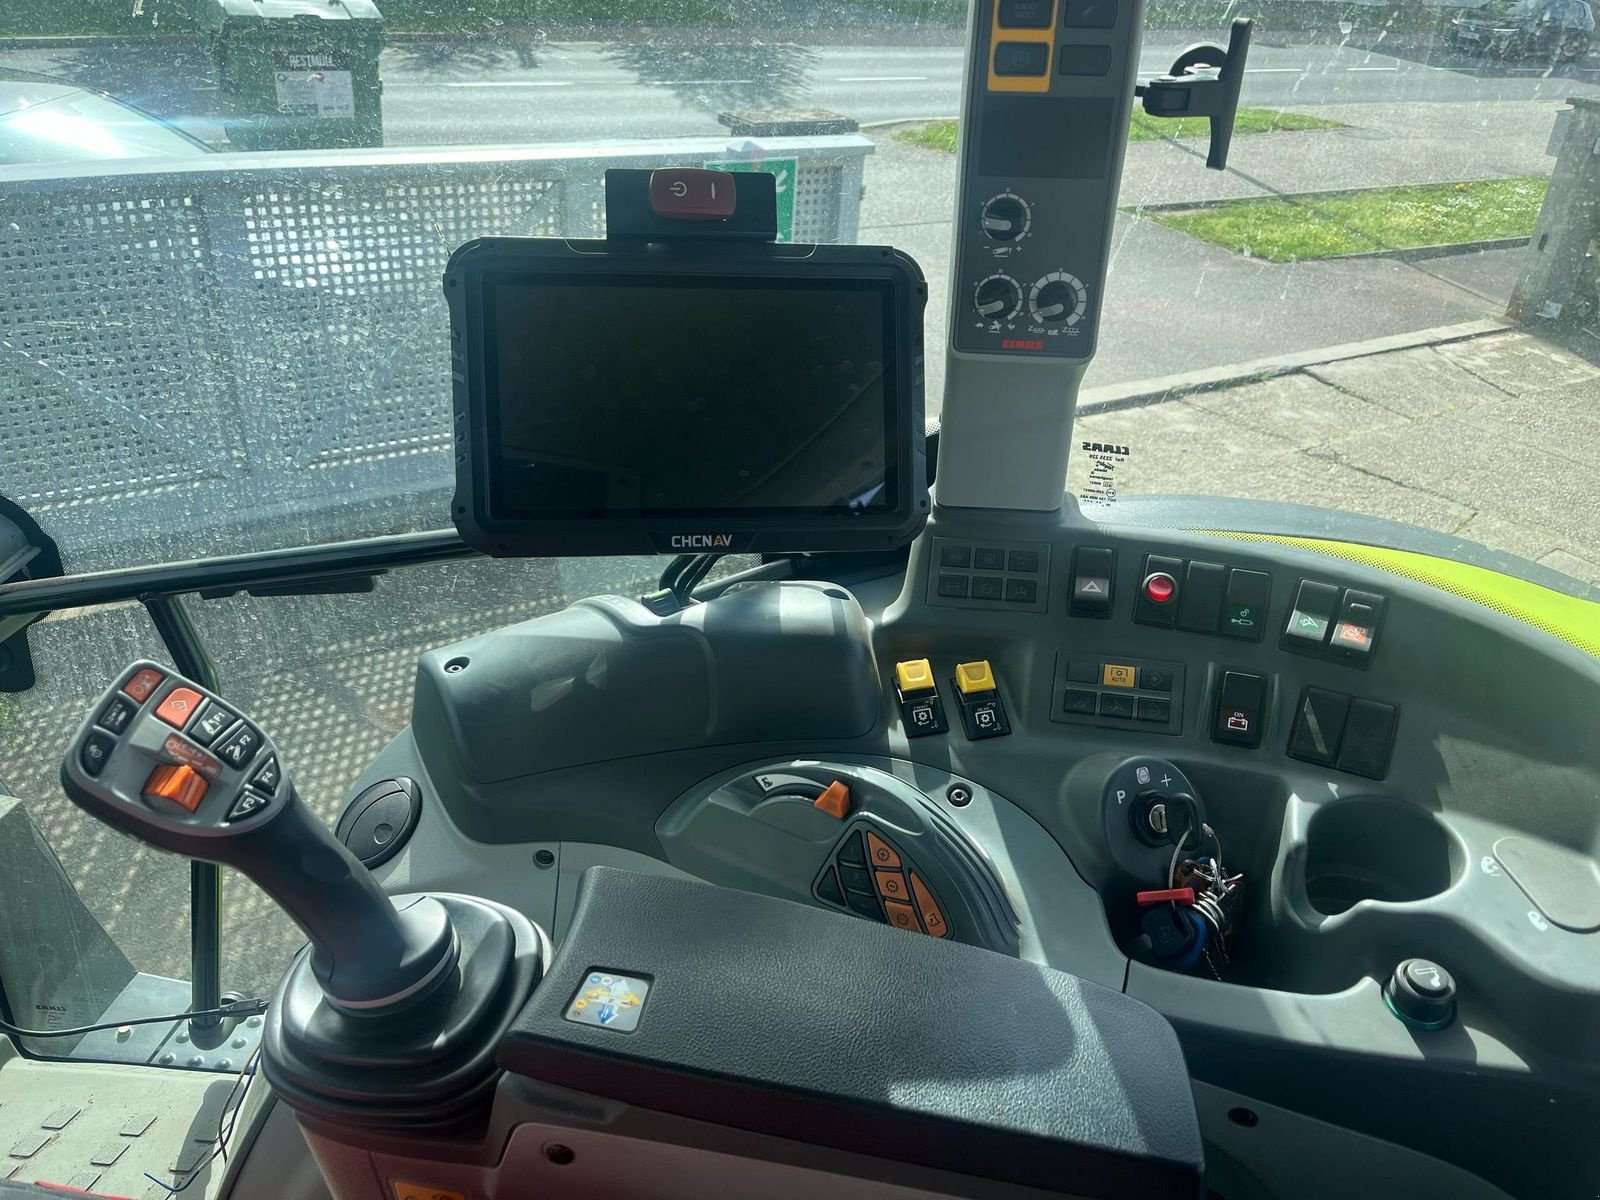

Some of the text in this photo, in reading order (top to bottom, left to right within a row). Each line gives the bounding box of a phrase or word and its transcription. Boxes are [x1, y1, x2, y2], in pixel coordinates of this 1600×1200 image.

[1002, 339, 1043, 350] CLAAS
[671, 534, 732, 548] CHCNAV
[213, 712, 226, 721] F1
[239, 734, 252, 745] F2
[261, 771, 274, 783] F4
[242, 797, 255, 809] F3
[1116, 790, 1126, 804] P
